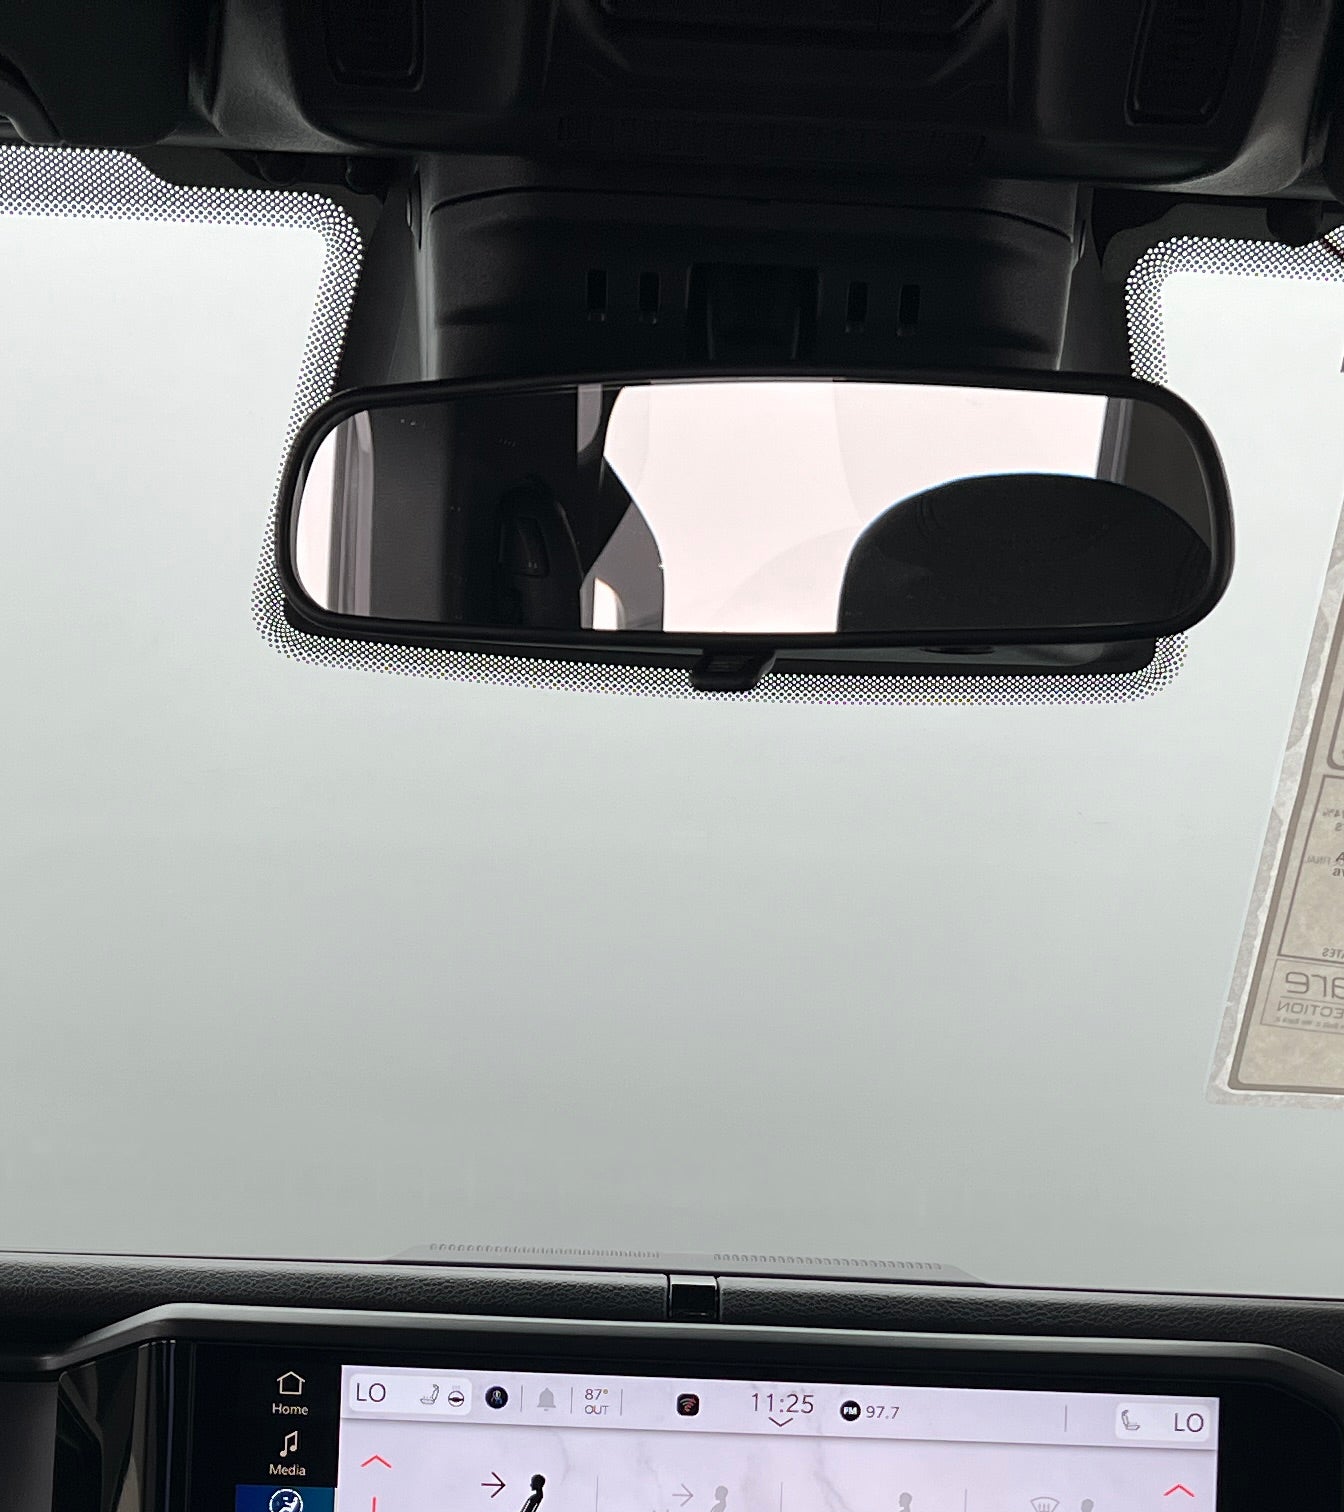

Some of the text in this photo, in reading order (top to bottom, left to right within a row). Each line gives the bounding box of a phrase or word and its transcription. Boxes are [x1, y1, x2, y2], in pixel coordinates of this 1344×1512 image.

[356, 1383, 386, 1403] LO
[584, 1389, 608, 1401] 87°
[272, 1402, 308, 1416] Home
[584, 1404, 608, 1416] OUT
[751, 1392, 814, 1415] 11:25
[865, 1405, 899, 1419] 97.7
[1174, 1413, 1204, 1432] LO
[269, 1464, 306, 1476] Media
